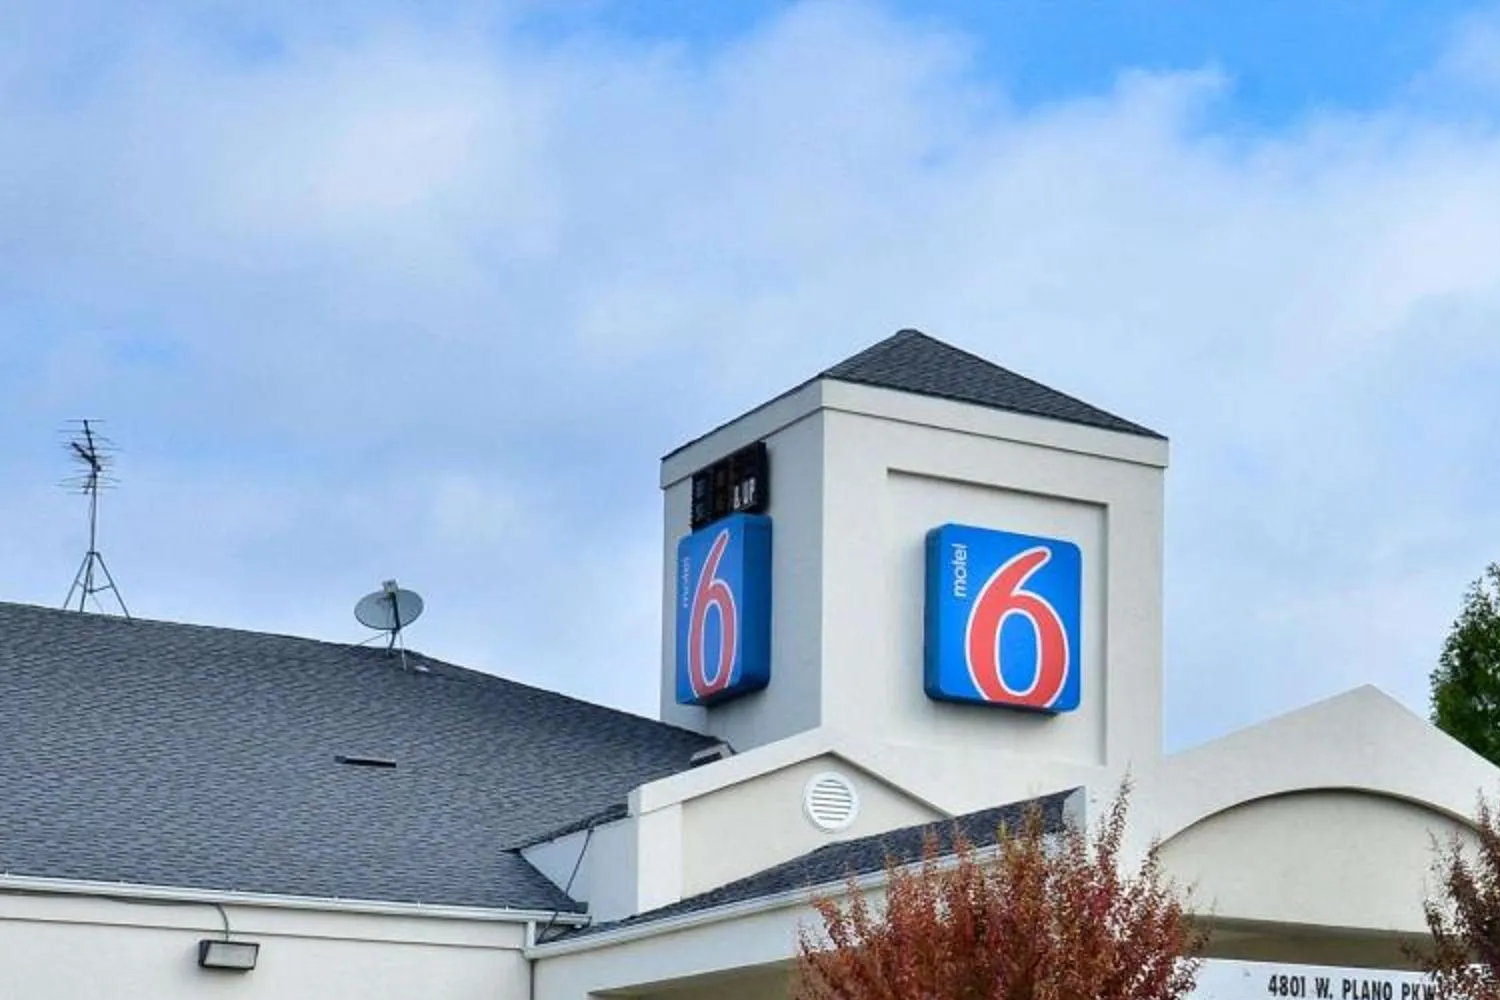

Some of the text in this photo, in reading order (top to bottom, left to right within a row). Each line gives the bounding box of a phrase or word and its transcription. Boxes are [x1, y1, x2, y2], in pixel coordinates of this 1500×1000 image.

[687, 528, 737, 699] 6
[951, 543, 968, 599] motel
[965, 546, 1070, 708] 6
[1267, 974, 1306, 998] 4801
[1314, 977, 1334, 1000] W.
